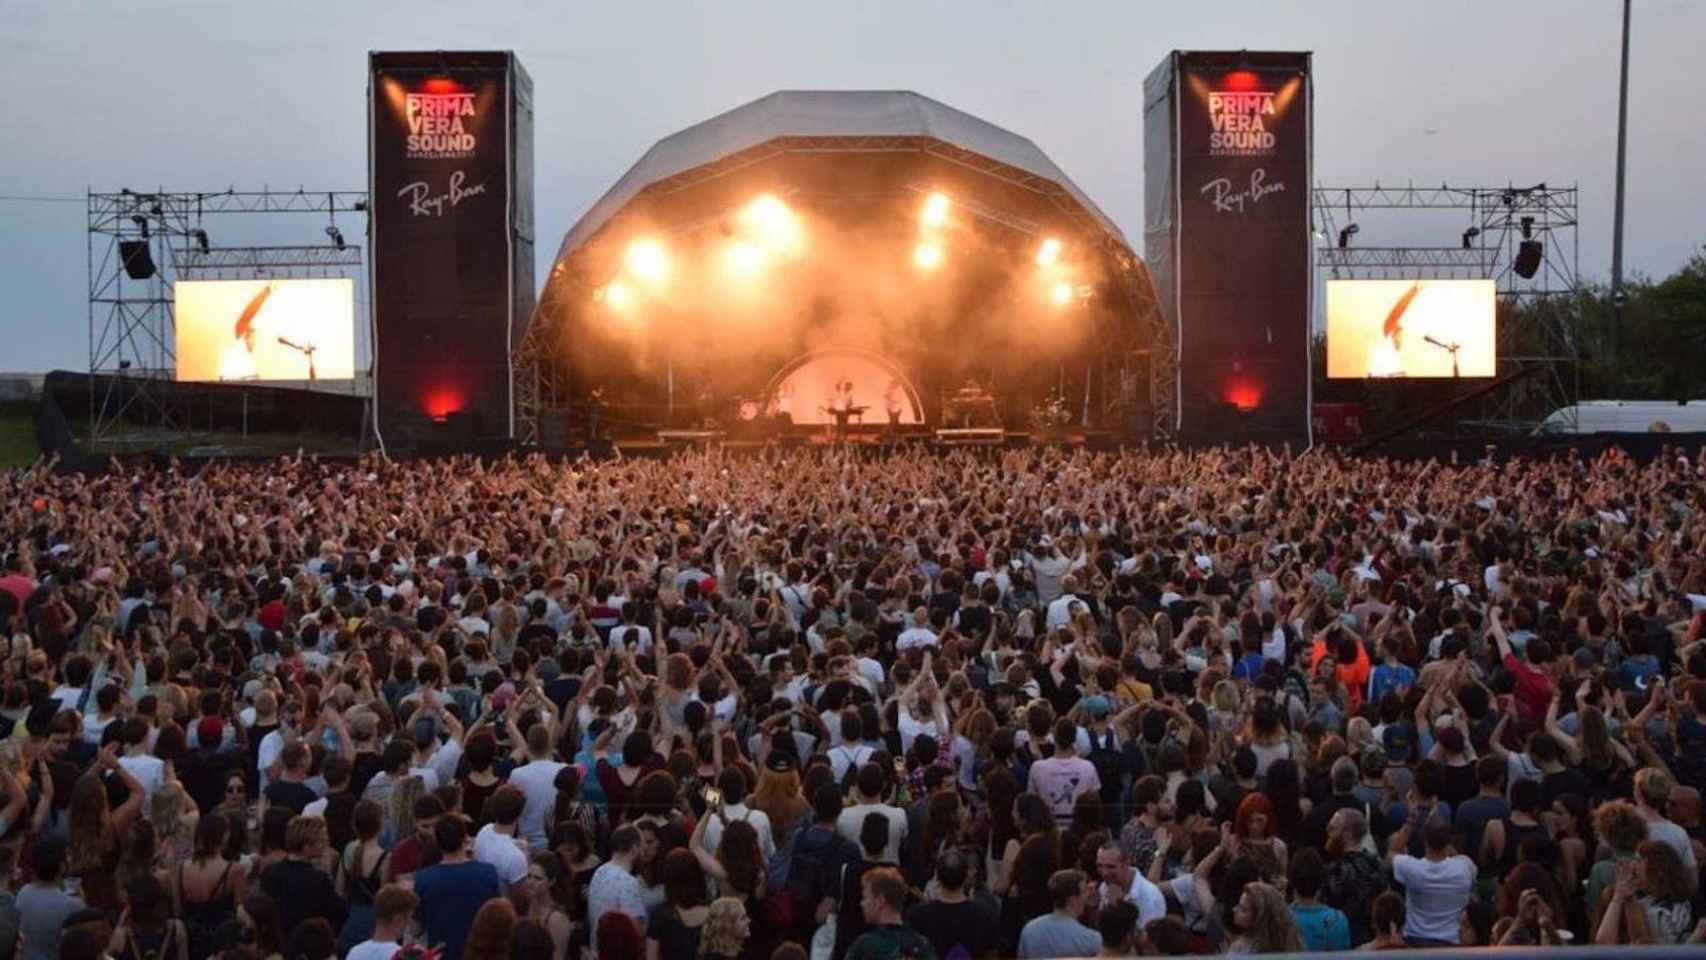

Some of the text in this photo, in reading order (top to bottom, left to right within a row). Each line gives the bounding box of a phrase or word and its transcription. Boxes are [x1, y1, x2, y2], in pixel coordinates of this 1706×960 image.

[406, 98, 475, 116] PRIMA
[1208, 95, 1275, 114] PRIMA
[407, 115, 464, 134] VERA
[1210, 113, 1264, 131] VERA
[407, 133, 475, 151] SOUND
[1210, 131, 1275, 149] SOUND
[397, 170, 486, 216] Ray-Ban
[1200, 168, 1286, 213] Ray-Ban
